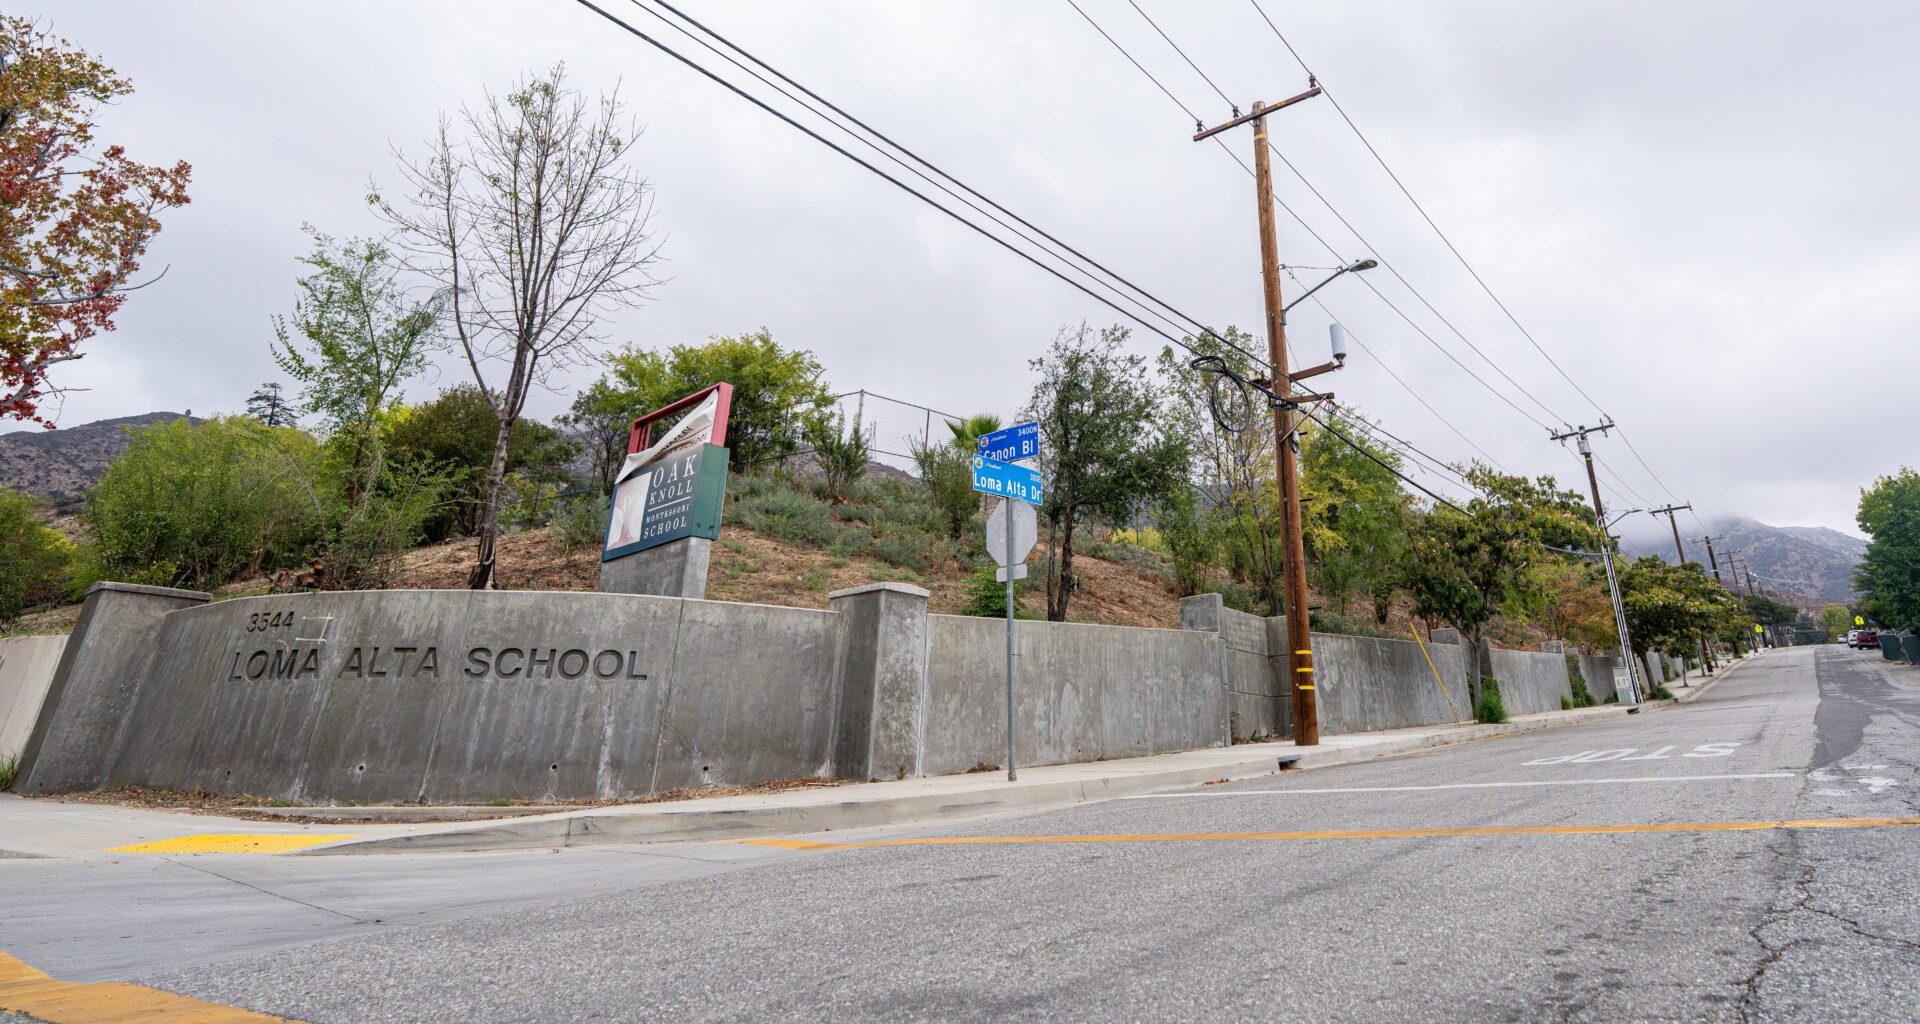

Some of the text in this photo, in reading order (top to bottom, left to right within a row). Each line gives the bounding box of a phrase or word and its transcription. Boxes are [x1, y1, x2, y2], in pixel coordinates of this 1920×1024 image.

[984, 439, 1034, 461] Canon Bl
[653, 454, 697, 489] OAK
[648, 479, 692, 506] KNOLL
[974, 472, 1041, 501] Loma Alta Dr
[645, 503, 690, 524] MONTESSORI
[643, 516, 687, 539] SCHOOL
[246, 611, 295, 633] 3544
[227, 646, 648, 682] LOMA ALTA SCHOOL
[1520, 742, 1742, 766] STOP
